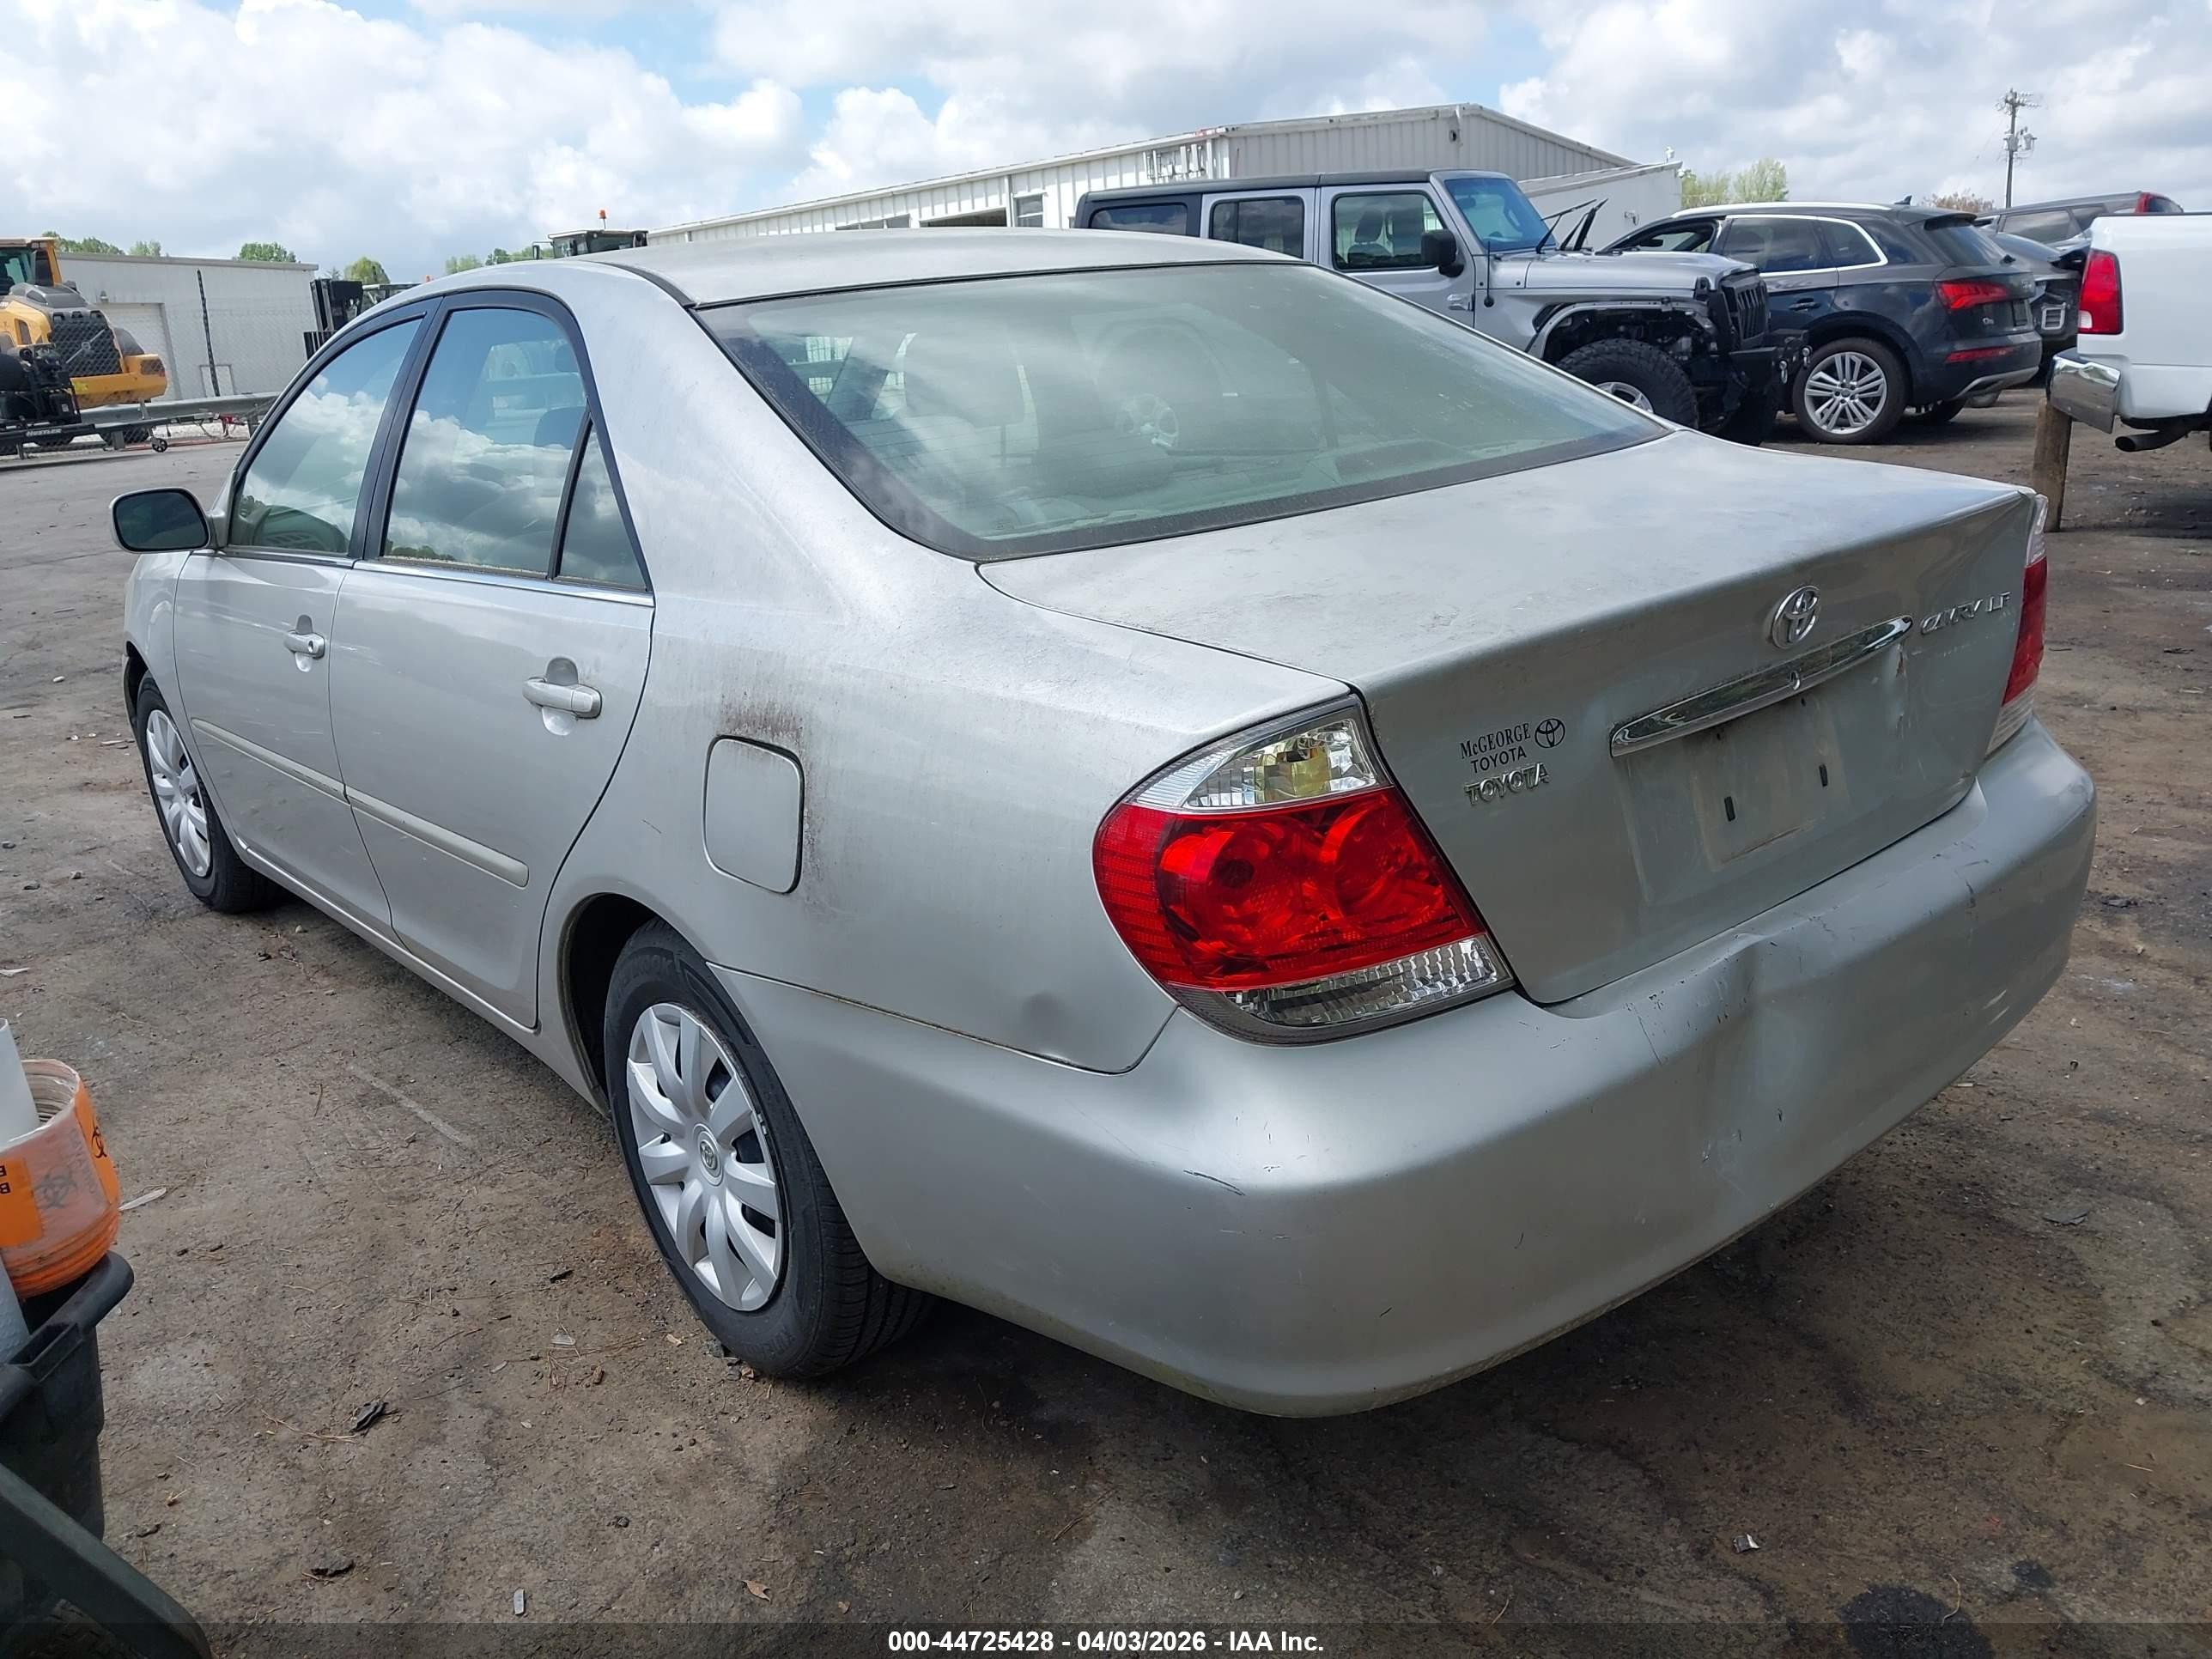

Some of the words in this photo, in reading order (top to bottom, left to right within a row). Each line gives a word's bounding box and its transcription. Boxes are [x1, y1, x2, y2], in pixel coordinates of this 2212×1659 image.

[1460, 722, 1531, 759] McGEORGE
[1470, 745, 1527, 774] TOYOTA
[1463, 762, 1550, 805] TOYOTA
